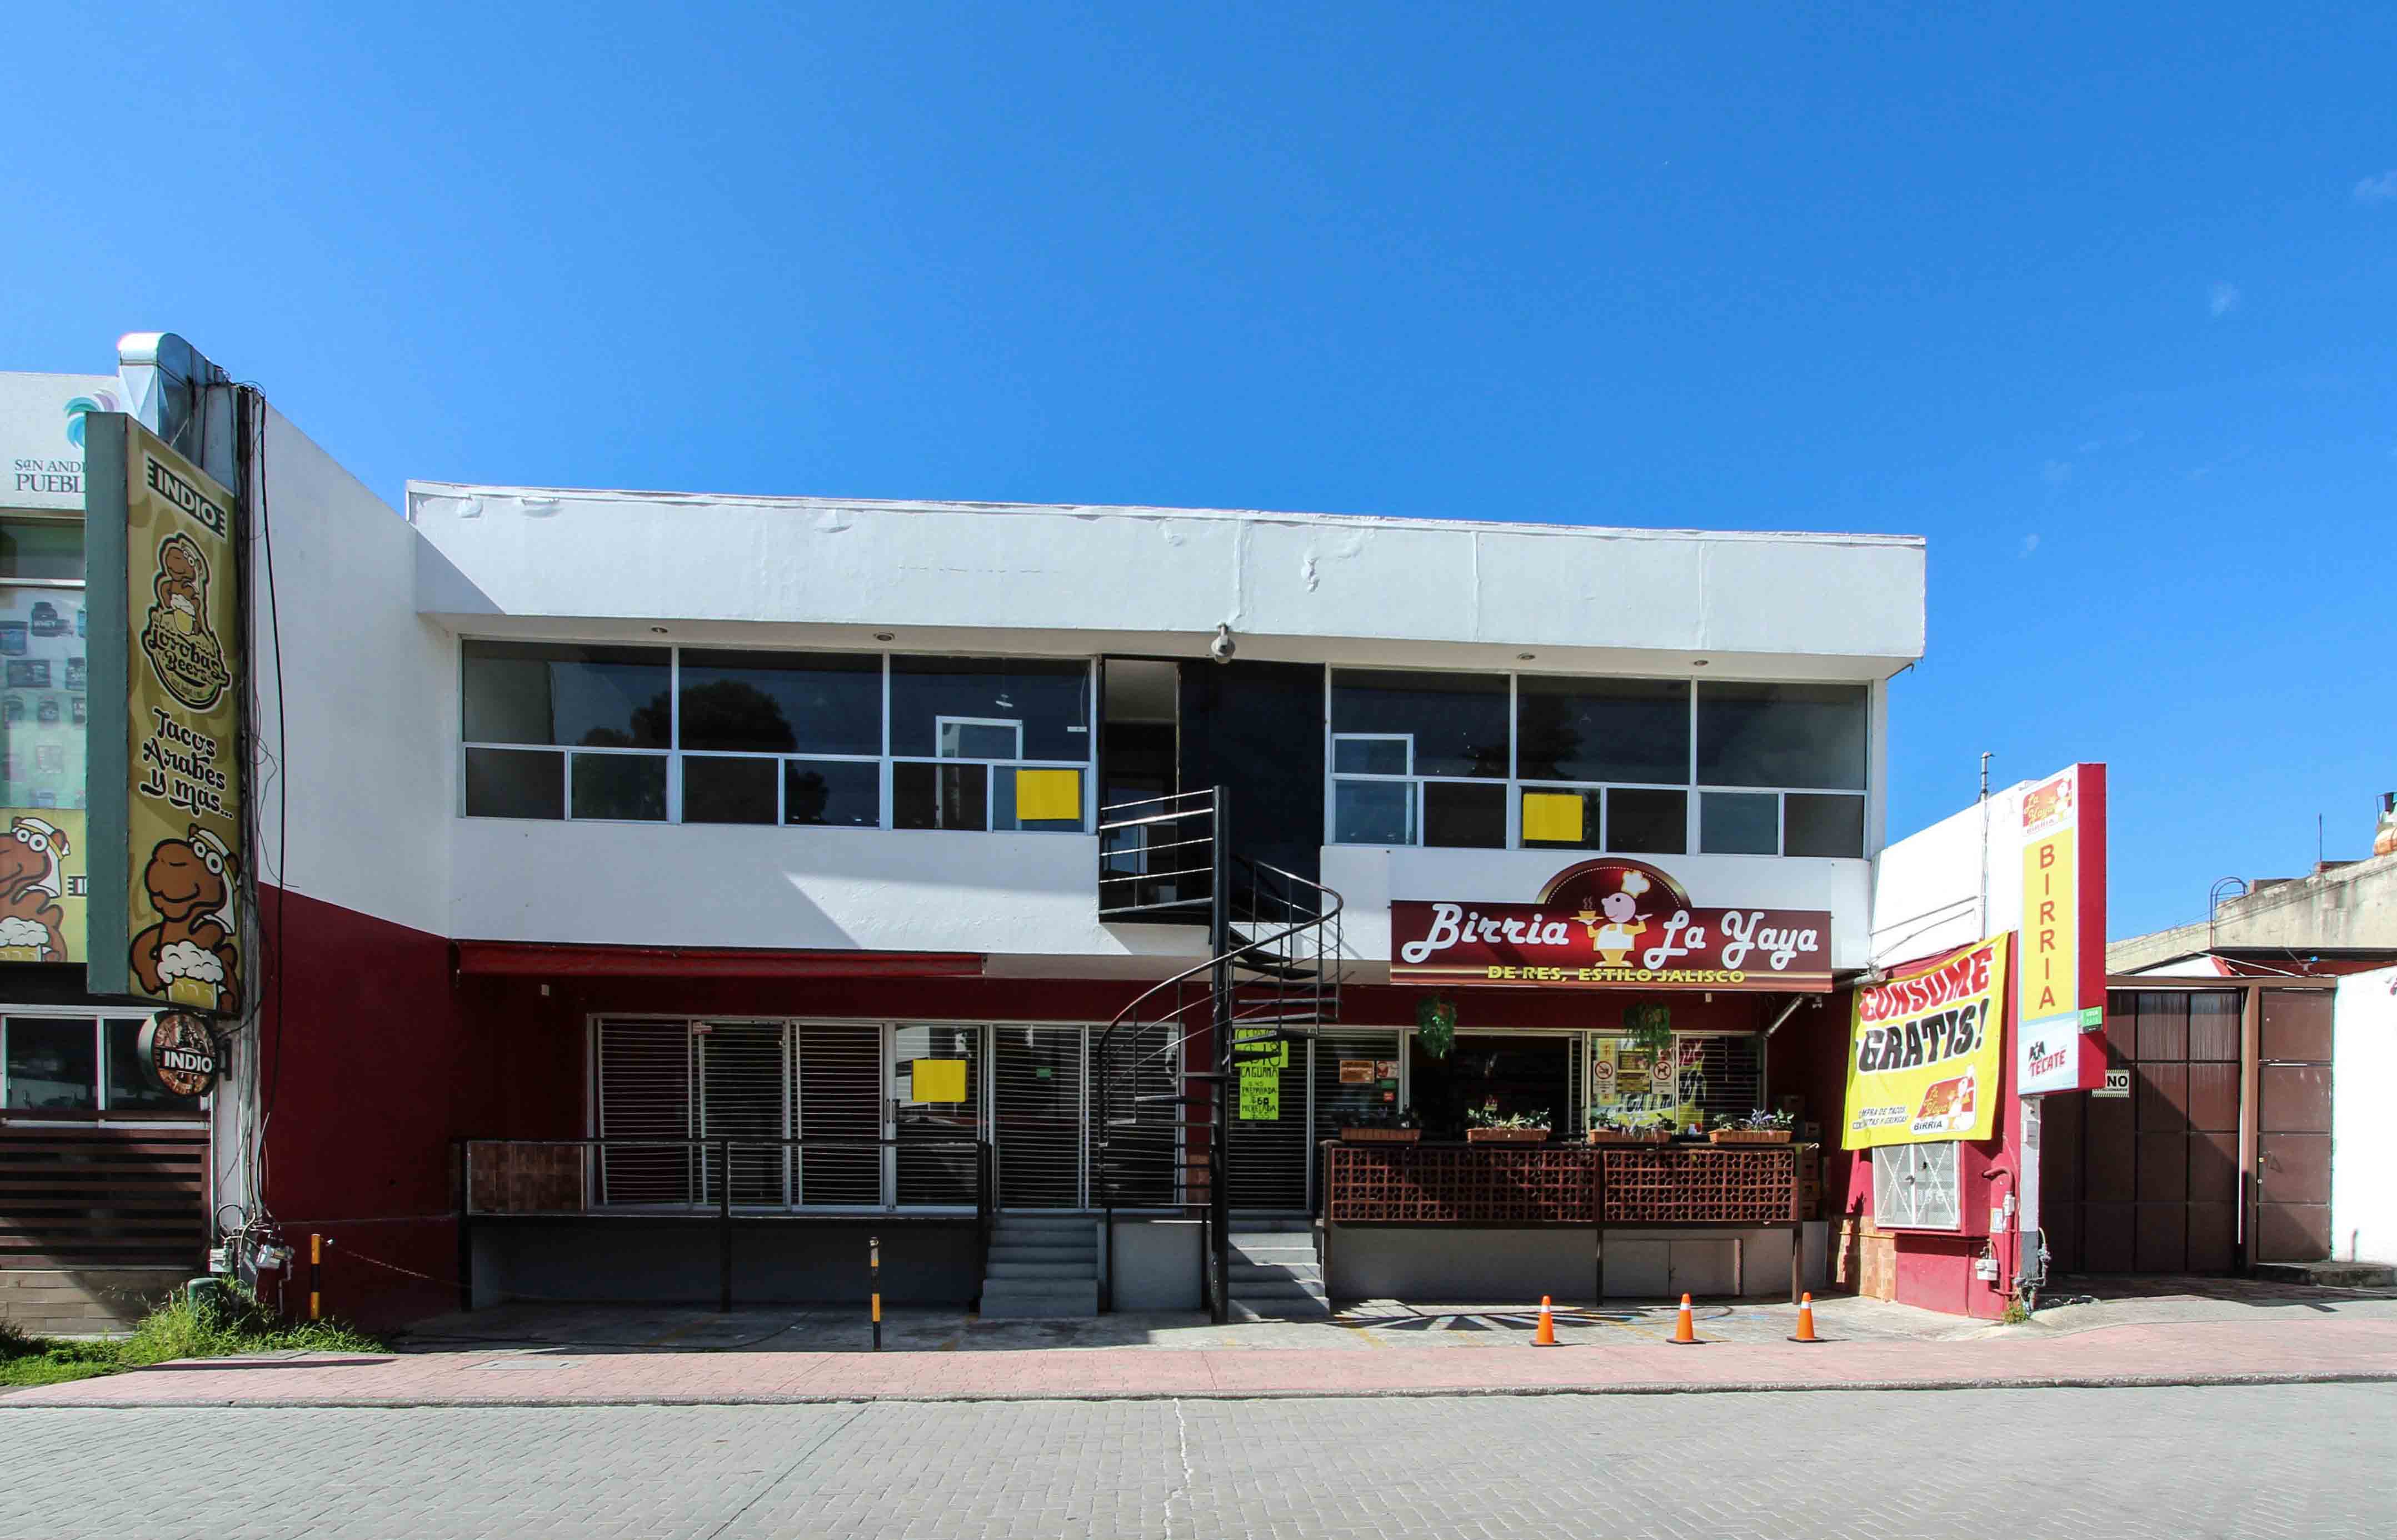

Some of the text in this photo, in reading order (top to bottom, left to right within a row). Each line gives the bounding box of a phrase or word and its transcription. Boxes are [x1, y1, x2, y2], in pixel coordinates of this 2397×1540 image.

[48, 461, 85, 473] AND
[15, 473, 86, 493] PUEBL
[156, 467, 217, 527] INDIO
[153, 707, 216, 757] Tacos
[143, 737, 226, 791] Arabes
[1401, 903, 1819, 971] Birria La Yaya
[2039, 843, 2055, 1009] BIRRIA
[1487, 966, 1746, 984] DE RES, ESTILO JALISCO
[1859, 947, 1992, 1022] CONSUME
[164, 1051, 213, 1073] INDIO
[2029, 1049, 2066, 1077] TECATE
[2107, 1076, 2128, 1087] NO
[1913, 1120, 1943, 1131] BIRRIA
